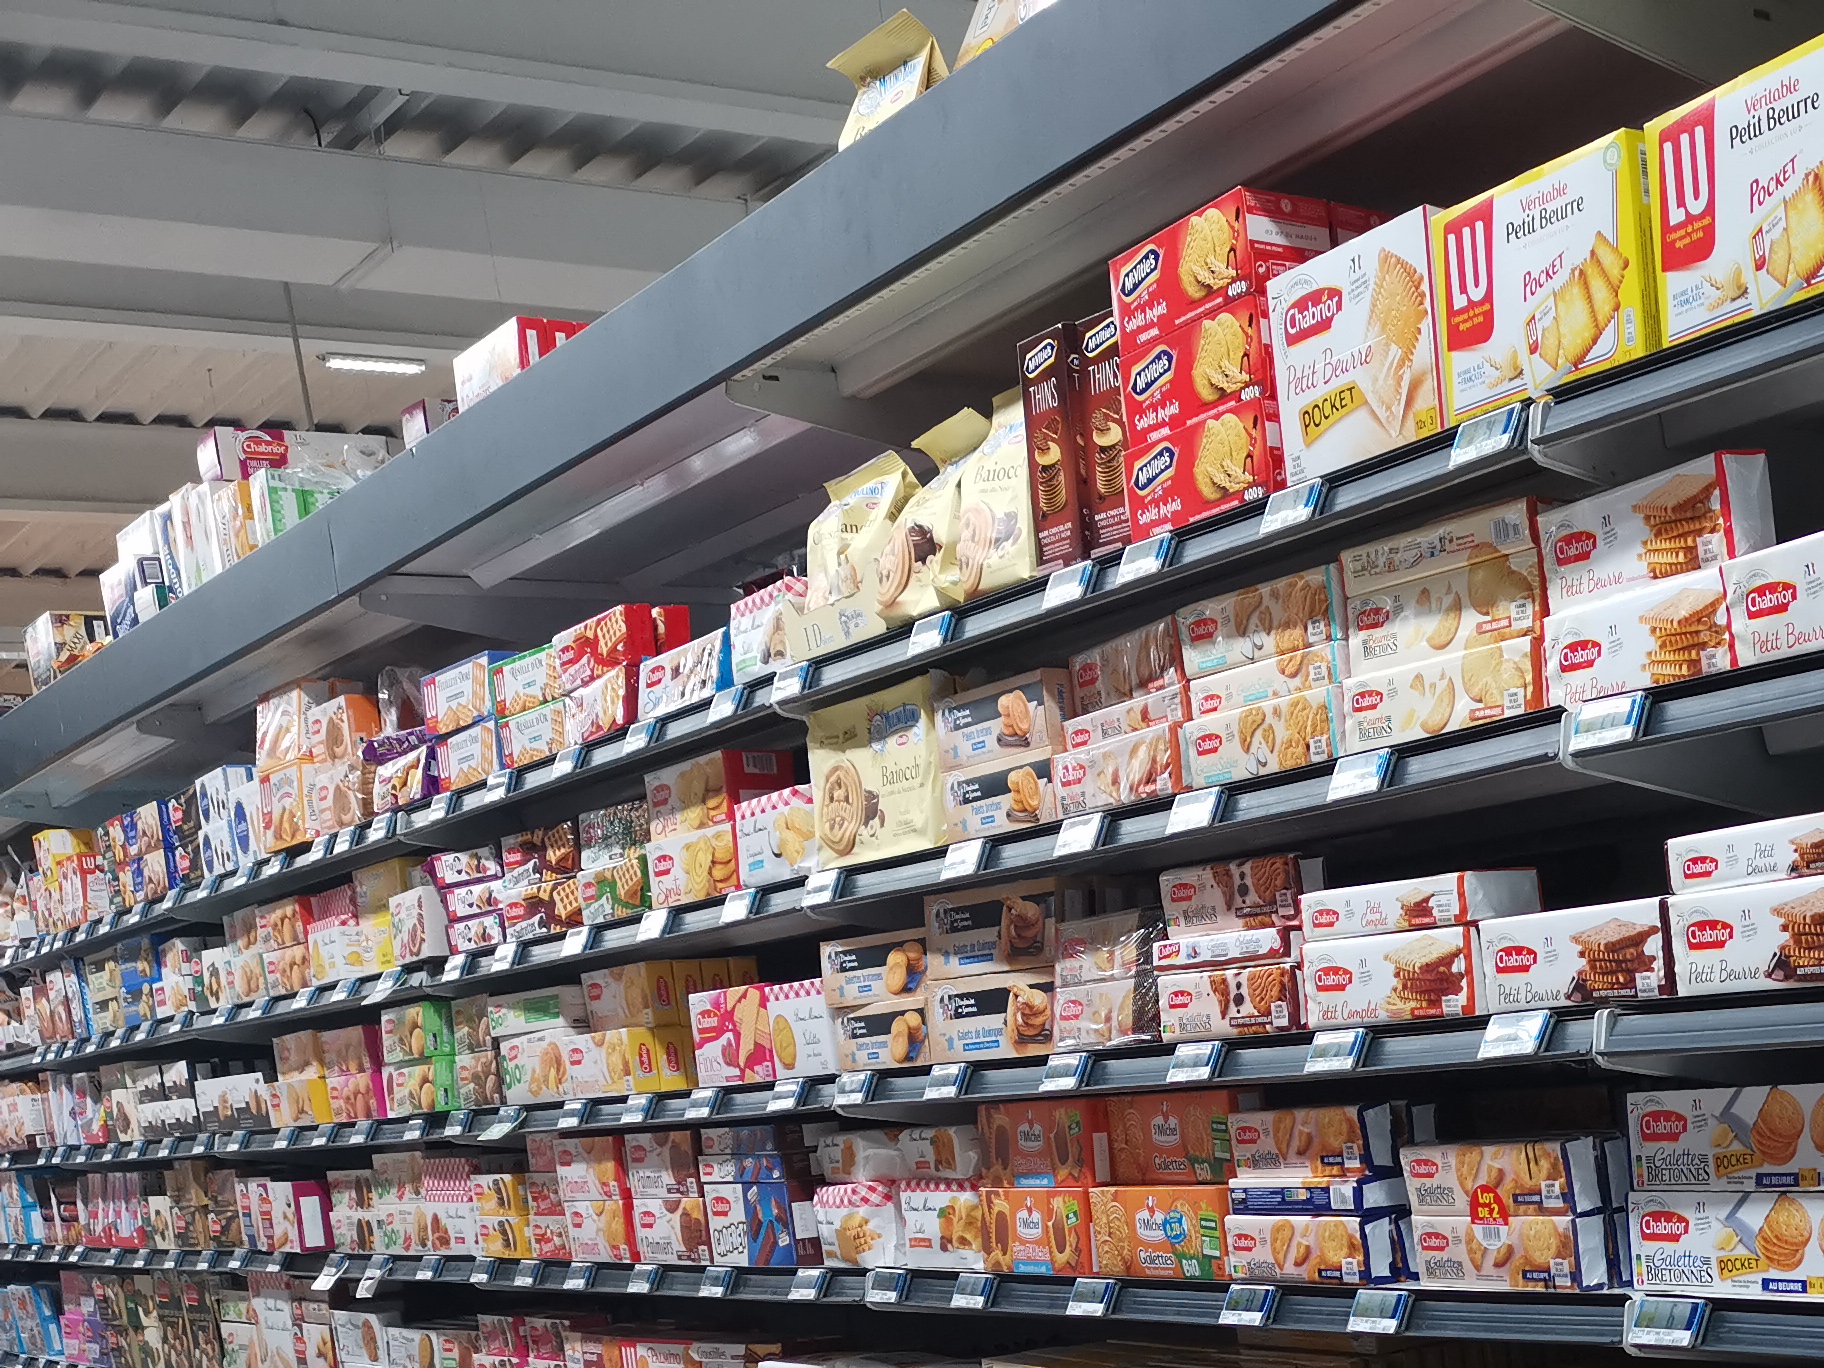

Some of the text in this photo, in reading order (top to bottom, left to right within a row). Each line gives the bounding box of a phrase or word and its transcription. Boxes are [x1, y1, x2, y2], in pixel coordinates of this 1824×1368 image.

[1744, 76, 1800, 116] Véritable
[1729, 91, 1821, 151] Petit Beurre
[1666, 128, 1710, 223] LU
[1750, 157, 1799, 214] POCKET
[1506, 193, 1585, 244] Petit Beurre
[1447, 220, 1487, 310] LU
[1029, 378, 1058, 413] THINS
[1302, 389, 1354, 434] POCKET
[1688, 961, 1760, 984] Petit Beurre
[1720, 1258, 1760, 1273] POCKET
